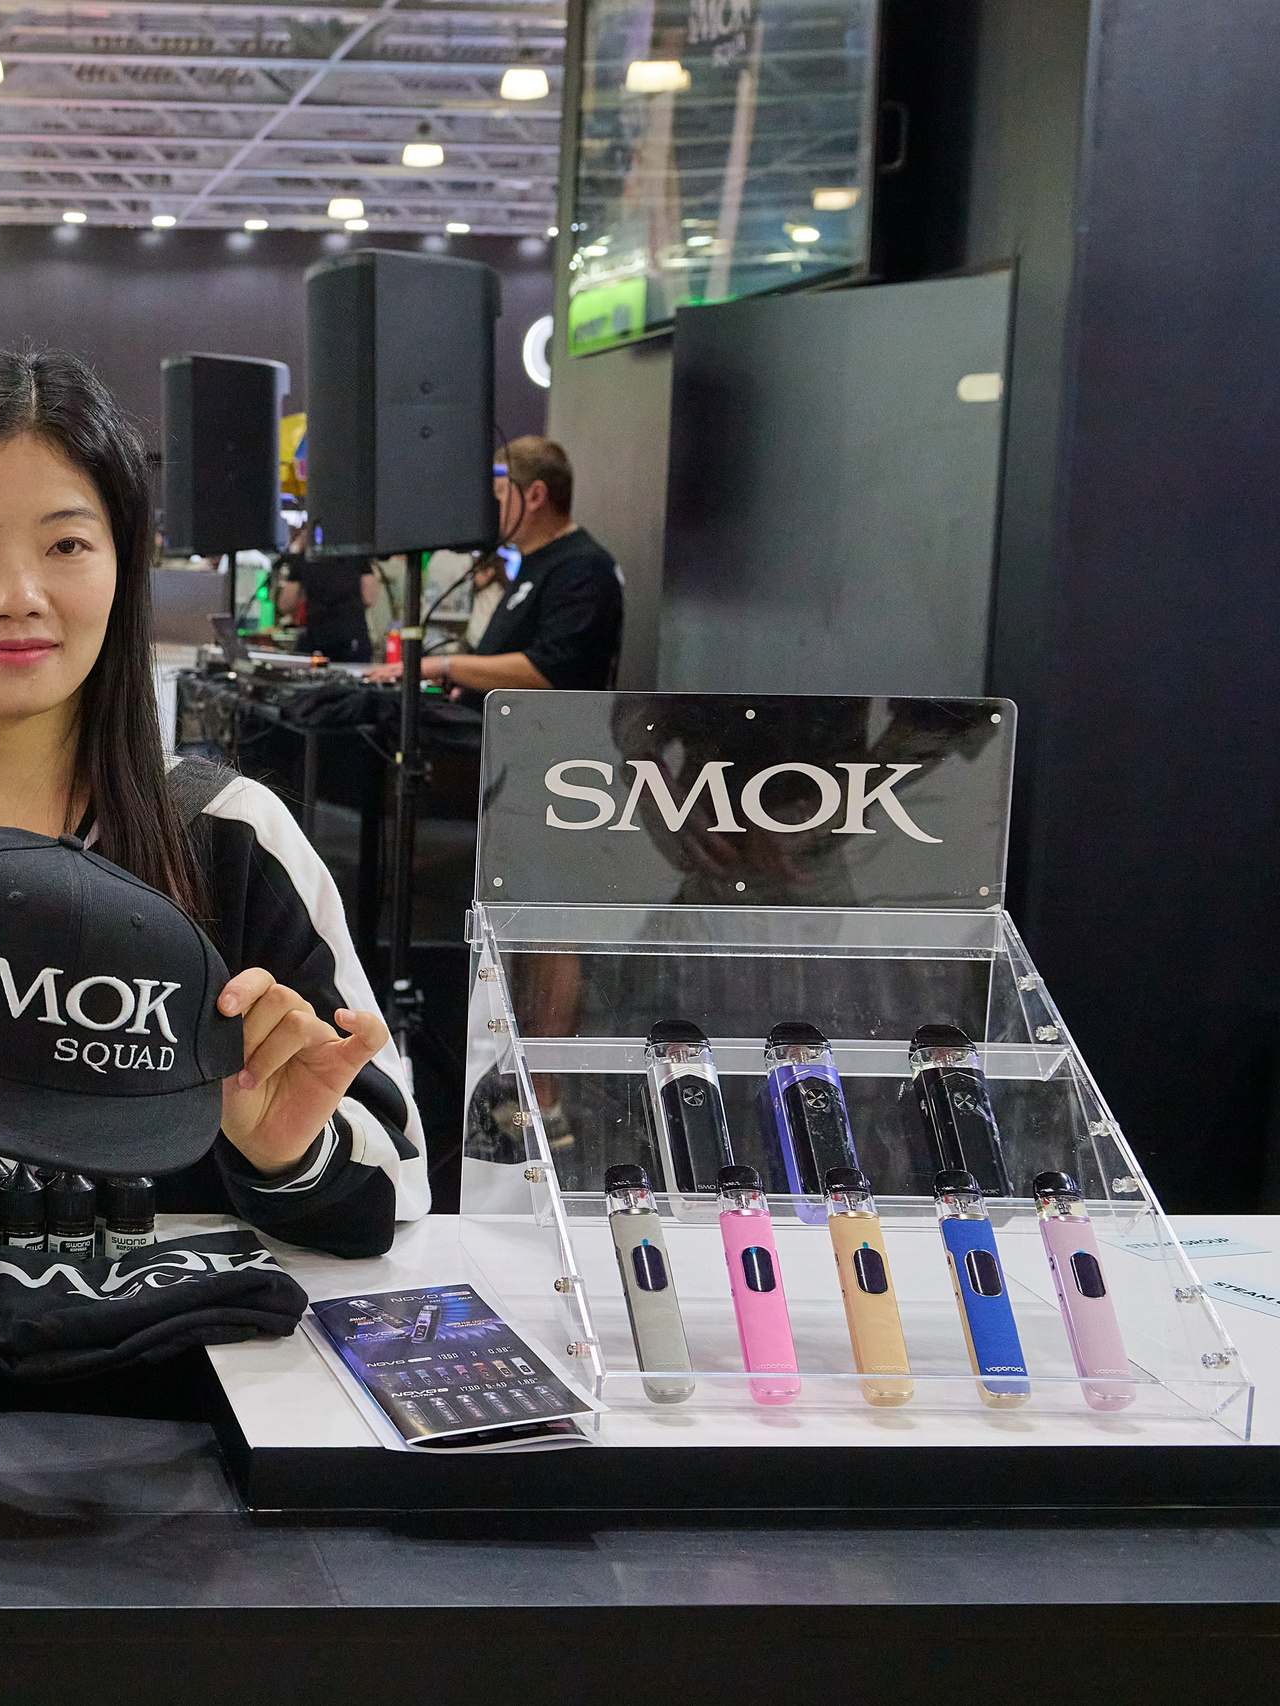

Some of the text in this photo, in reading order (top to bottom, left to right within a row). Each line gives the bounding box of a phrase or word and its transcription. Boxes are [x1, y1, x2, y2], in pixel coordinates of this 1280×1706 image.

[544, 759, 943, 844] SMOK
[54, 1037, 175, 1074] SQUAD
[390, 1293, 438, 1303] NOVO
[1214, 1281, 1275, 1301] STEAM
[366, 1359, 405, 1368] NOVO
